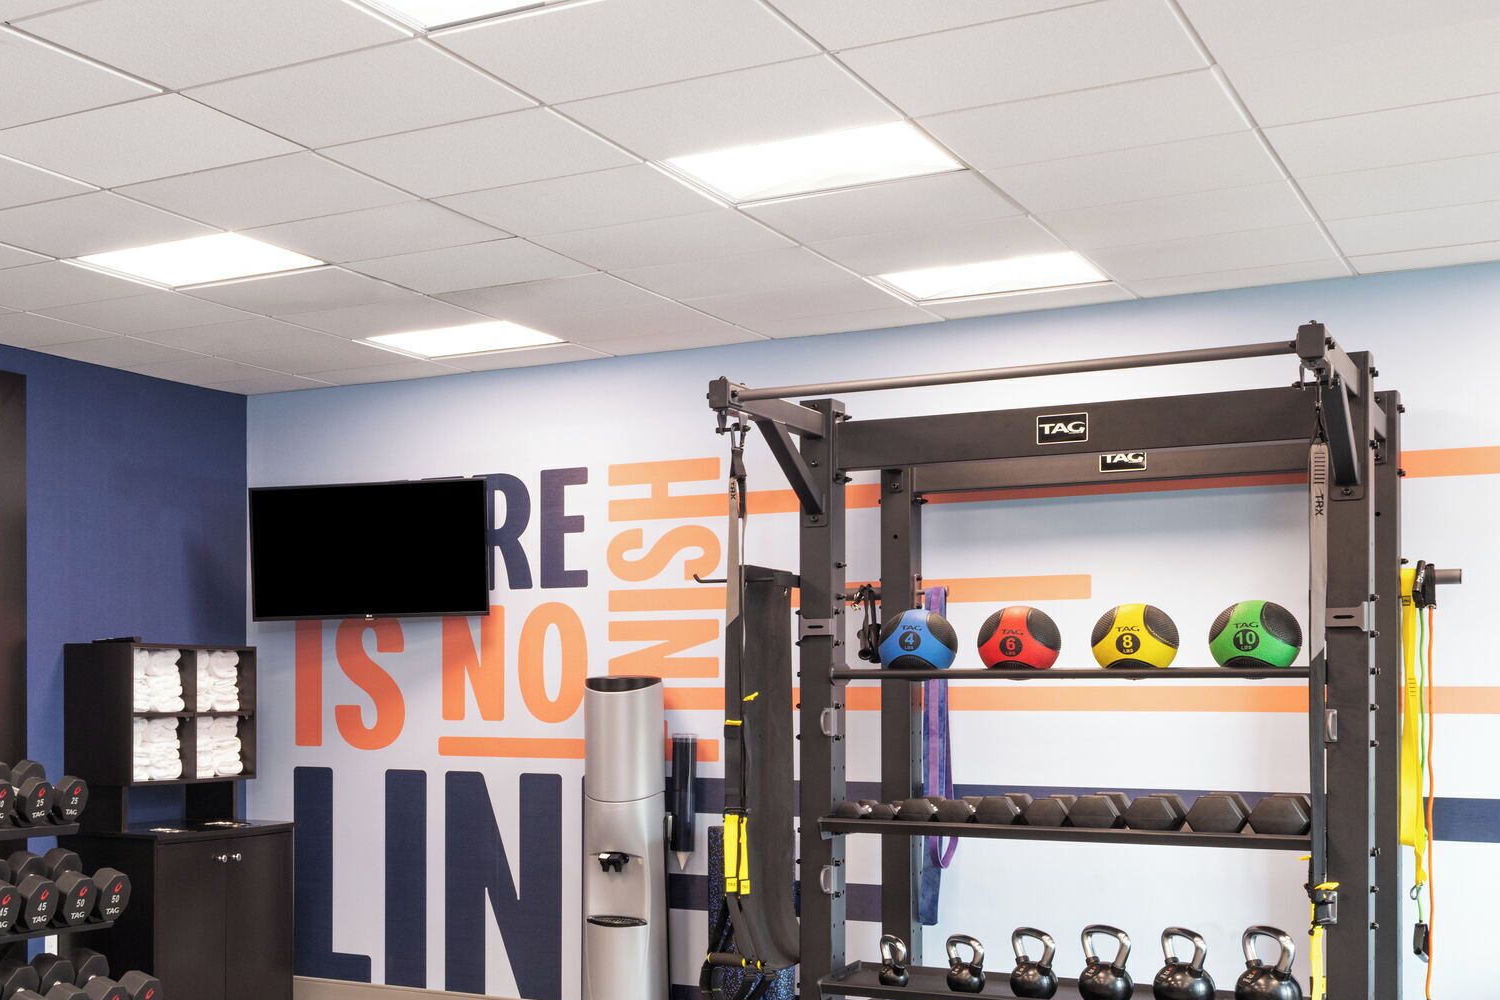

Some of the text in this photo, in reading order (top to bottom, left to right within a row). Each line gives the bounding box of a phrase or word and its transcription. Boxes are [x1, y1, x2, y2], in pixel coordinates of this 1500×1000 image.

[1039, 421, 1086, 435] TAG
[1101, 452, 1144, 464] TAG
[1314, 493, 1325, 516] TRX
[1233, 621, 1259, 629] TAG
[1002, 628, 1025, 636] TAG
[904, 632, 915, 646] 4
[1122, 634, 1133, 648] 8
[1235, 631, 1256, 645] 10
[1005, 639, 1016, 651] 6
[295, 601, 589, 751] IS NO
[36, 798, 44, 808] 25
[70, 796, 79, 805] 25
[32, 810, 46, 819] TAG
[65, 808, 79, 816] TAG
[76, 898, 86, 908] 50
[111, 894, 120, 904] 50
[37, 902, 47, 912] 45
[105, 906, 120, 915] TAG
[32, 914, 48, 924] TAG
[70, 911, 85, 920] TAG
